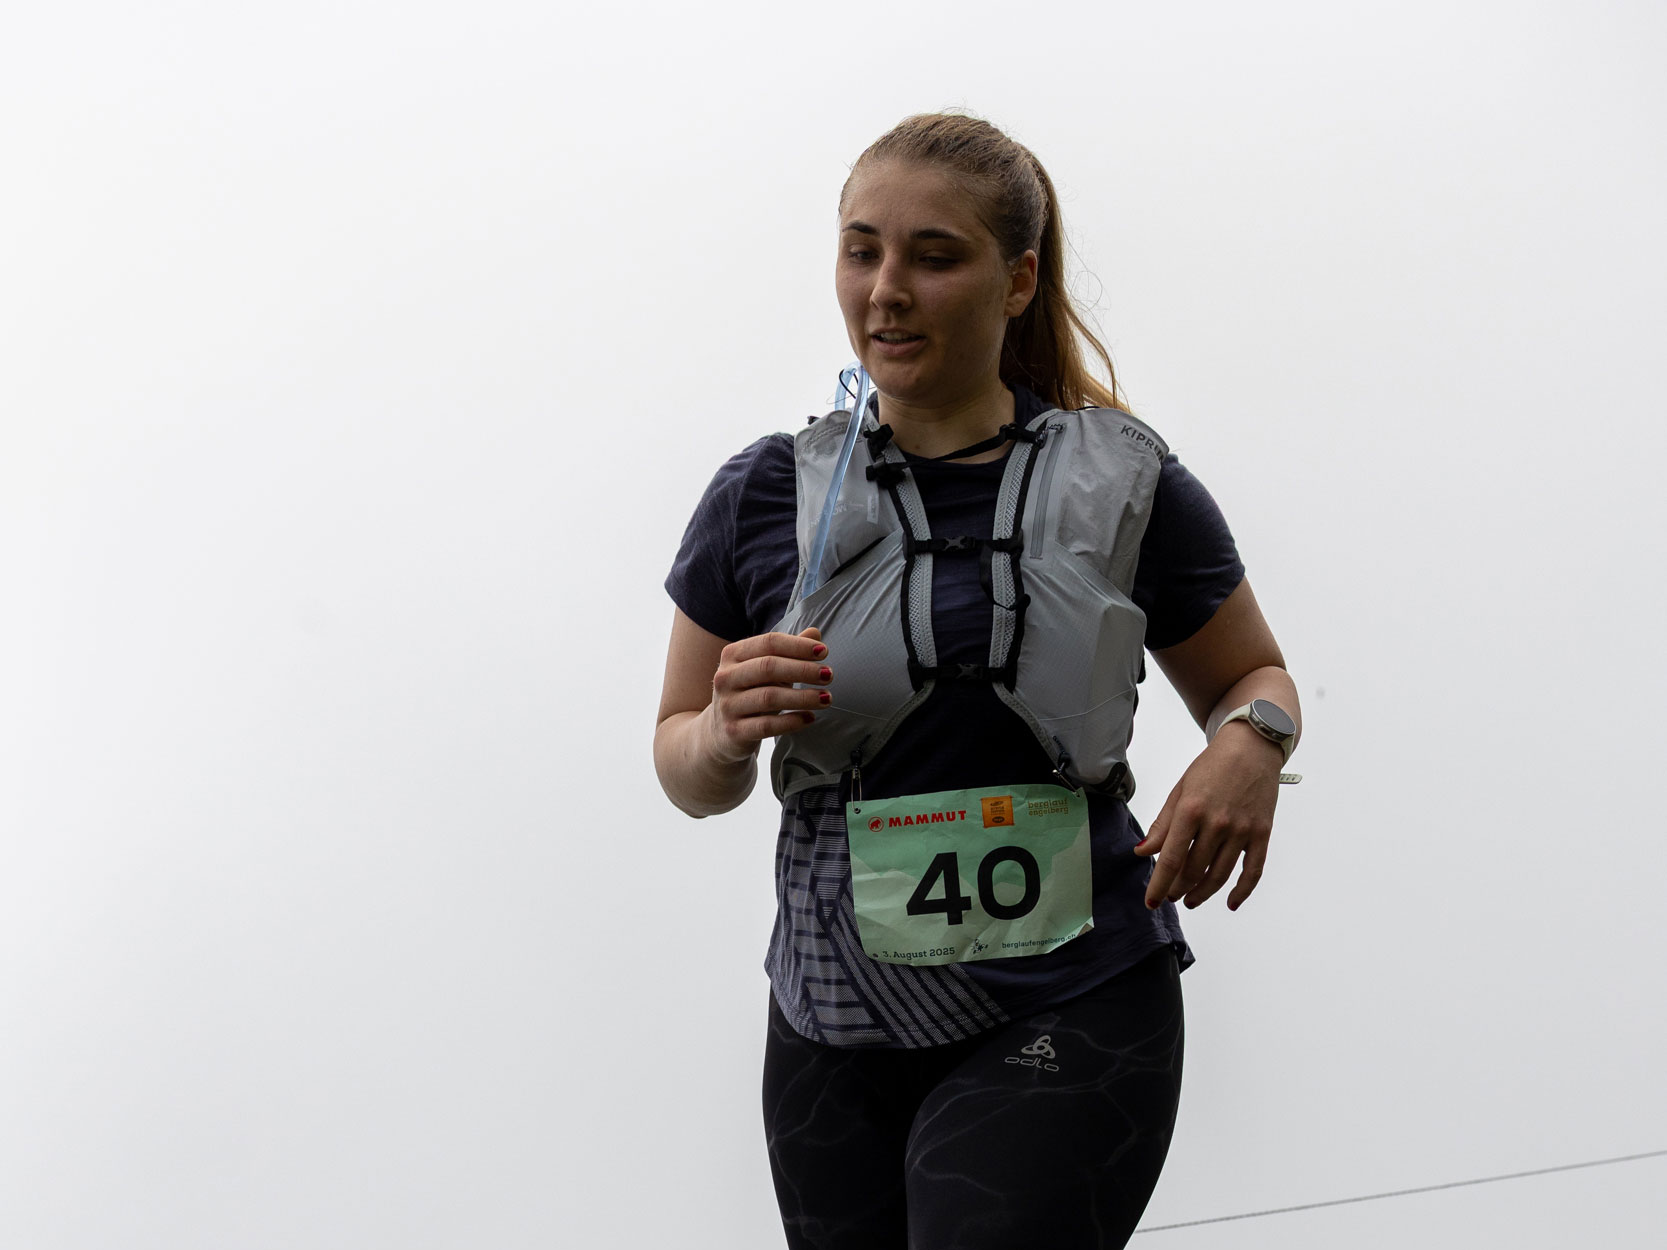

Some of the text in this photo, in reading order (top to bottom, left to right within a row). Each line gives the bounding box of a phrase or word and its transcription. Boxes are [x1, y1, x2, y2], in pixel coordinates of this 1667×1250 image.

[888, 810, 967, 828] MAMMUT
[906, 846, 1041, 926] 40
[893, 950, 928, 962] August
[929, 947, 956, 958] 2025
